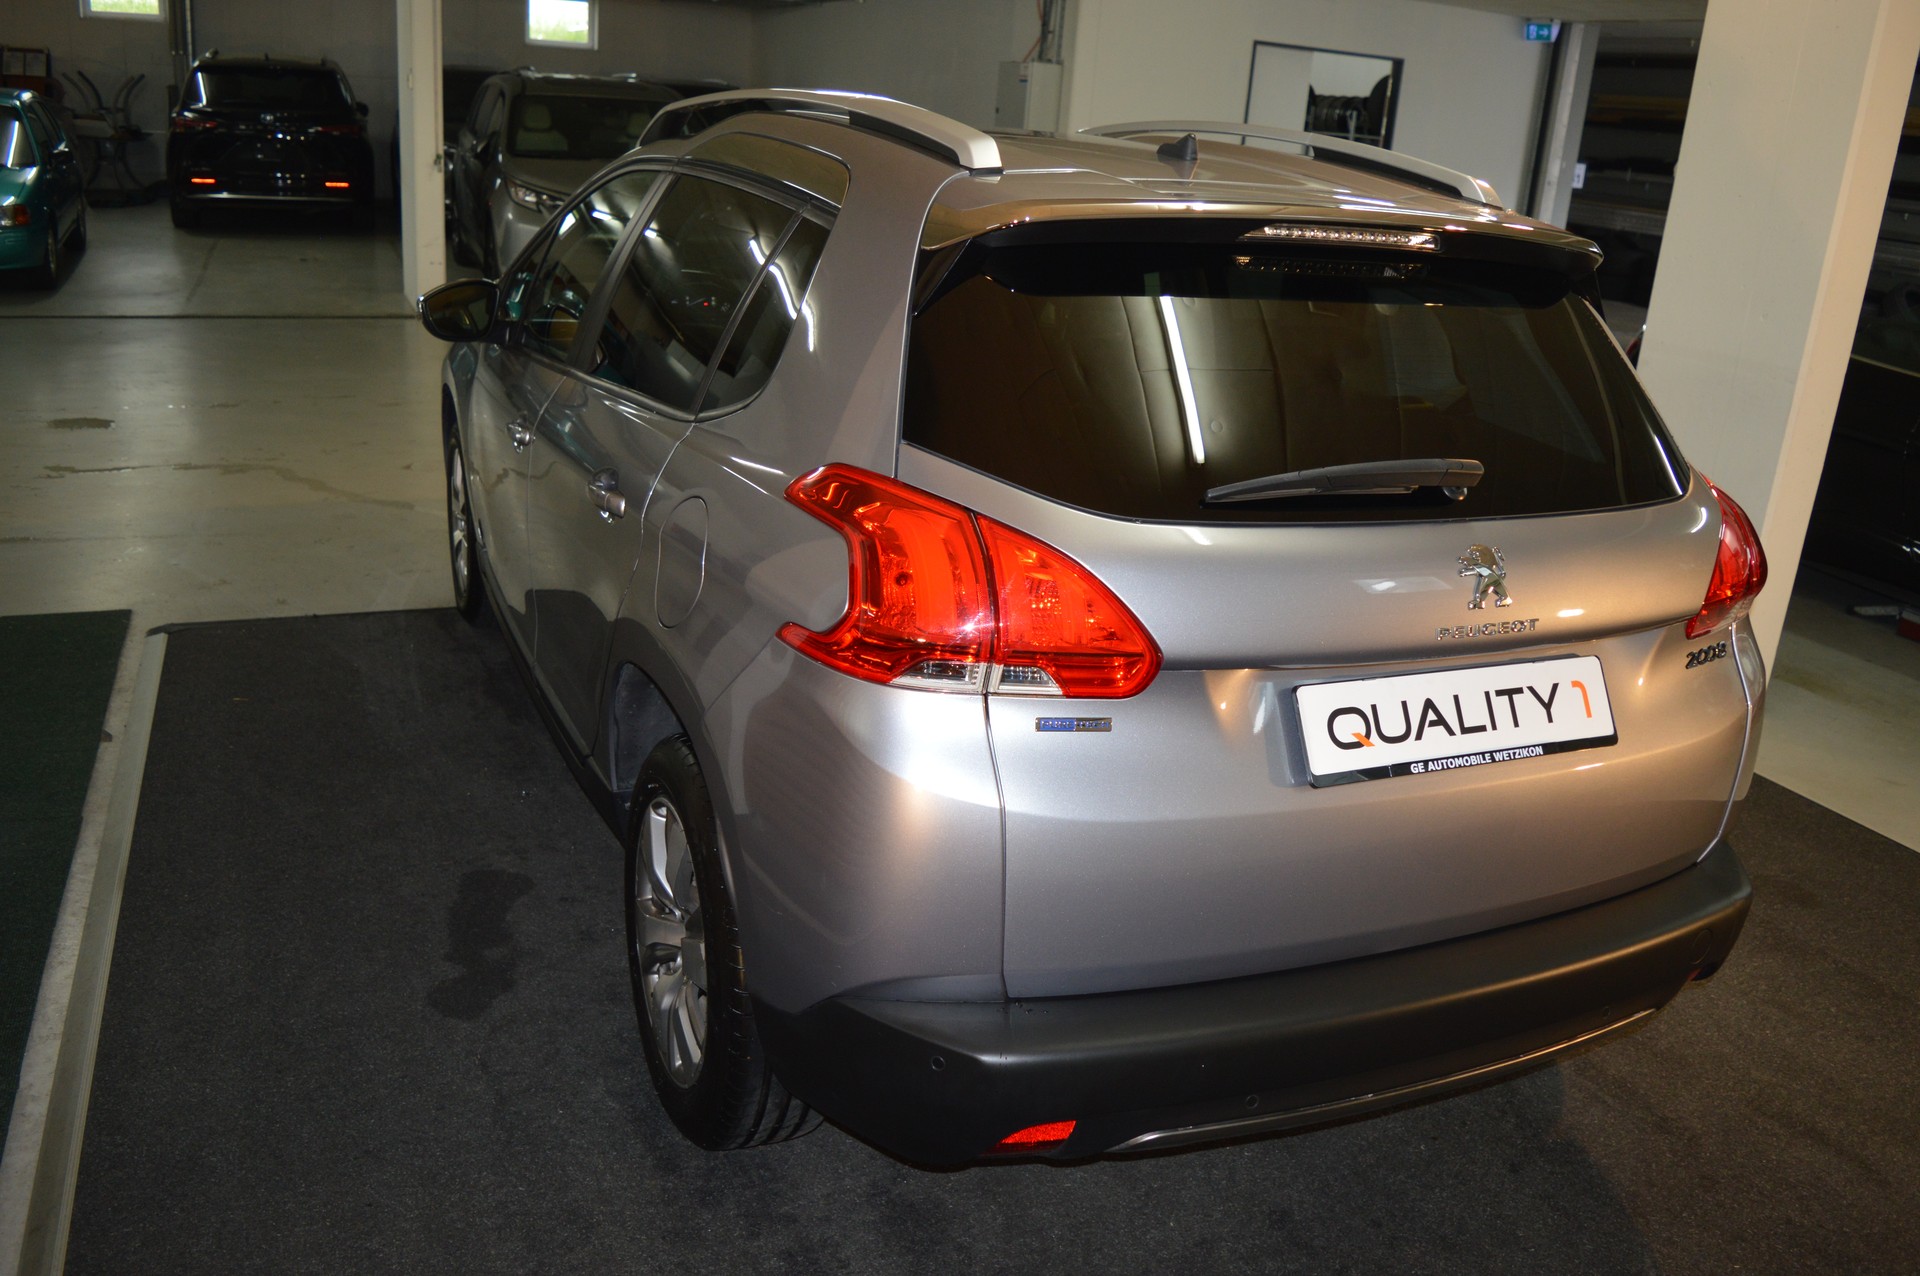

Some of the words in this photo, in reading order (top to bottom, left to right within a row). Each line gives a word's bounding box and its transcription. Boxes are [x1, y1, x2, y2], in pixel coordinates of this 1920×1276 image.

[1436, 618, 1539, 640] PEUGEOT
[1685, 642, 1727, 669] 2008
[1328, 682, 1560, 750] QUALITY
[1410, 762, 1426, 774] GE
[1427, 752, 1491, 772] AUTOMOBILE
[1493, 745, 1544, 763] WETZIKON
